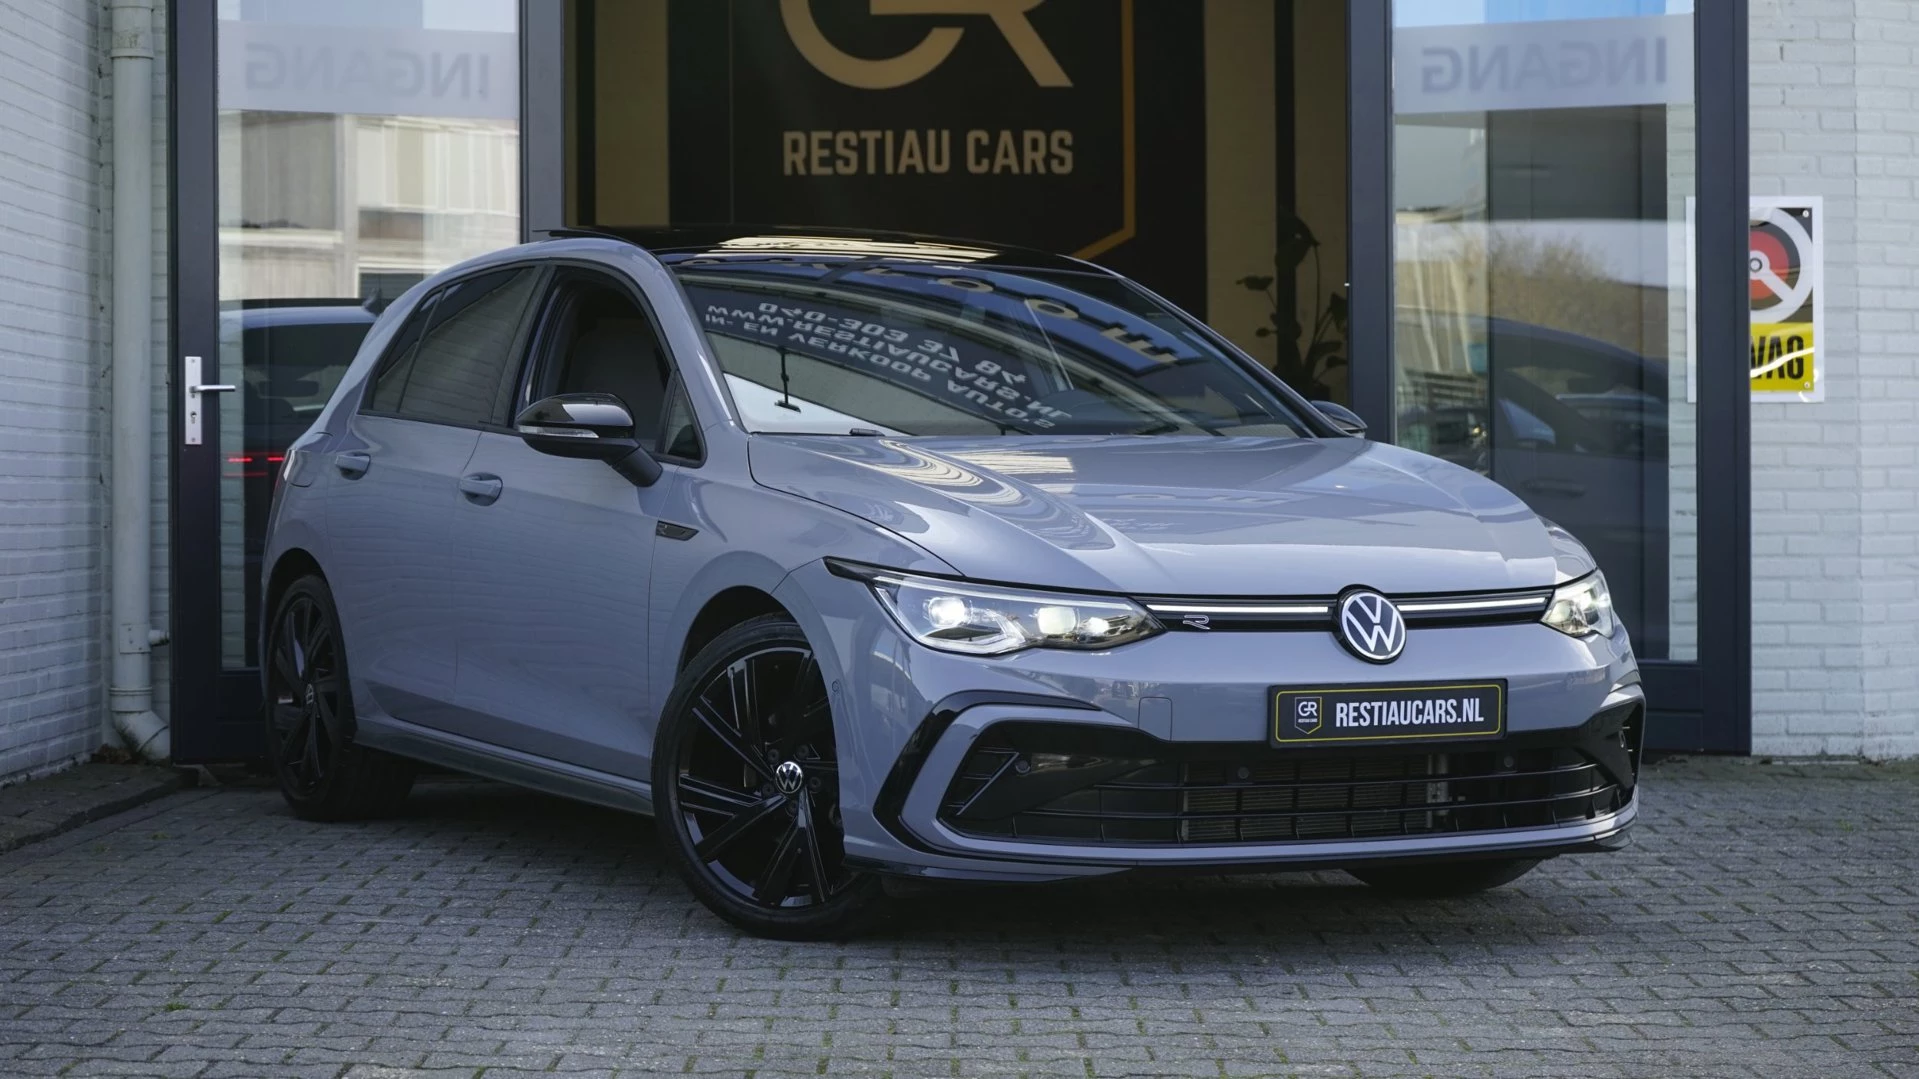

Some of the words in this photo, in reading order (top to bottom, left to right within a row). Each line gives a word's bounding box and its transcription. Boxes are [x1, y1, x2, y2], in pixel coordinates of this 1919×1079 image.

[783, 129, 950, 176] RESTIAU
[966, 129, 1075, 175] CARS
[1750, 335, 1805, 380] VAG
[1335, 697, 1485, 728] RESTIAUCARS.NL
